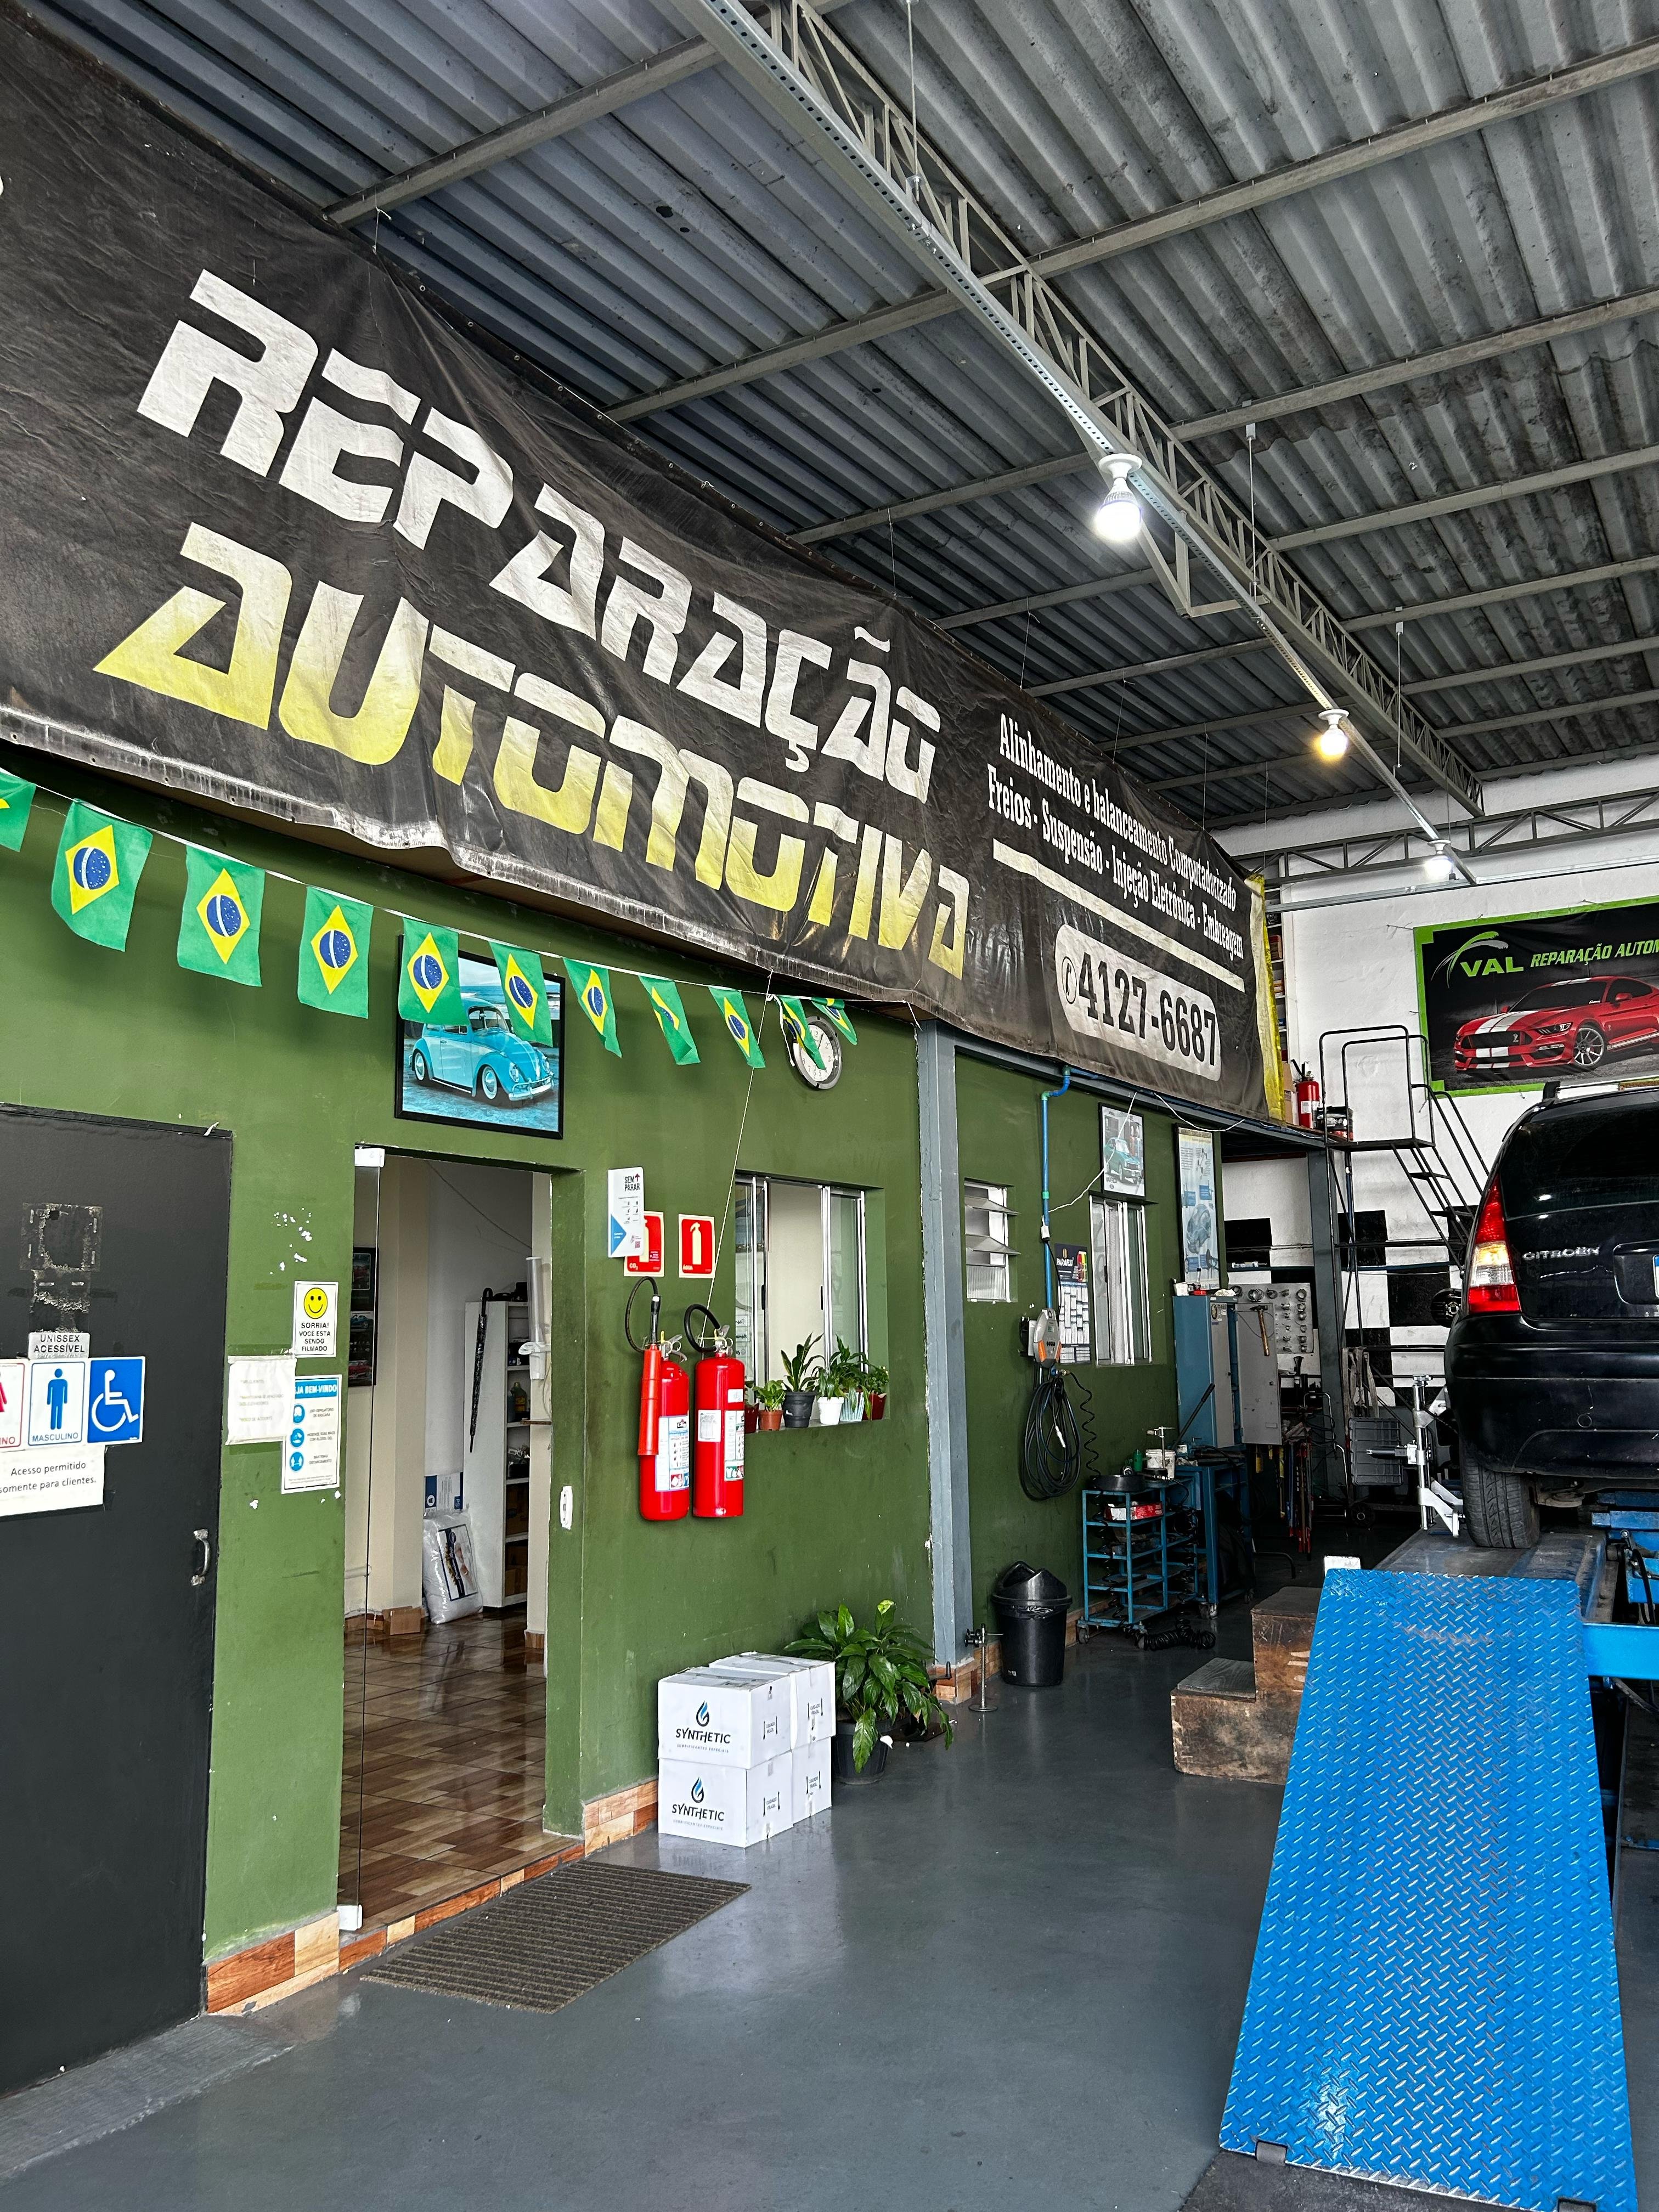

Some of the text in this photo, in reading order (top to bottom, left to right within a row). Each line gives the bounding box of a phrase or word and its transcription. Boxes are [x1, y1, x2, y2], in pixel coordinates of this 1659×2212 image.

[137, 268, 941, 804] REPARAÇÃO
[92, 522, 970, 980] AUTOMOTIVA
[1000, 713, 1237, 912] Alinhamento e balanceamento Computadorizado
[1042, 798, 1103, 874] Suspensão
[1112, 844, 1149, 909] Injeção
[1151, 869, 1195, 930] Eletrônica
[1203, 902, 1244, 960] Embreagem
[1459, 956, 1524, 977] VAL
[1530, 943, 1613, 968] REPARAÇÃO
[1079, 952, 1216, 1067] 4127-6687
[624, 1183, 640, 1192] PARAR
[1522, 1246, 1600, 1261] CITROËN
[40, 1334, 80, 1342] UNISSEX
[34, 1343, 84, 1353] ACESSÍVEL
[304, 1384, 337, 1393] BEM-VINDO
[32, 1432, 79, 1442] MASCULINO
[10, 1461, 86, 1476] Acesso permitido
[40, 1480, 59, 1492] para
[62, 1475, 97, 1487] clientes.
[675, 1727, 731, 1743] SYNTHETIC
[672, 1803, 725, 1821] SYNTHETIC
